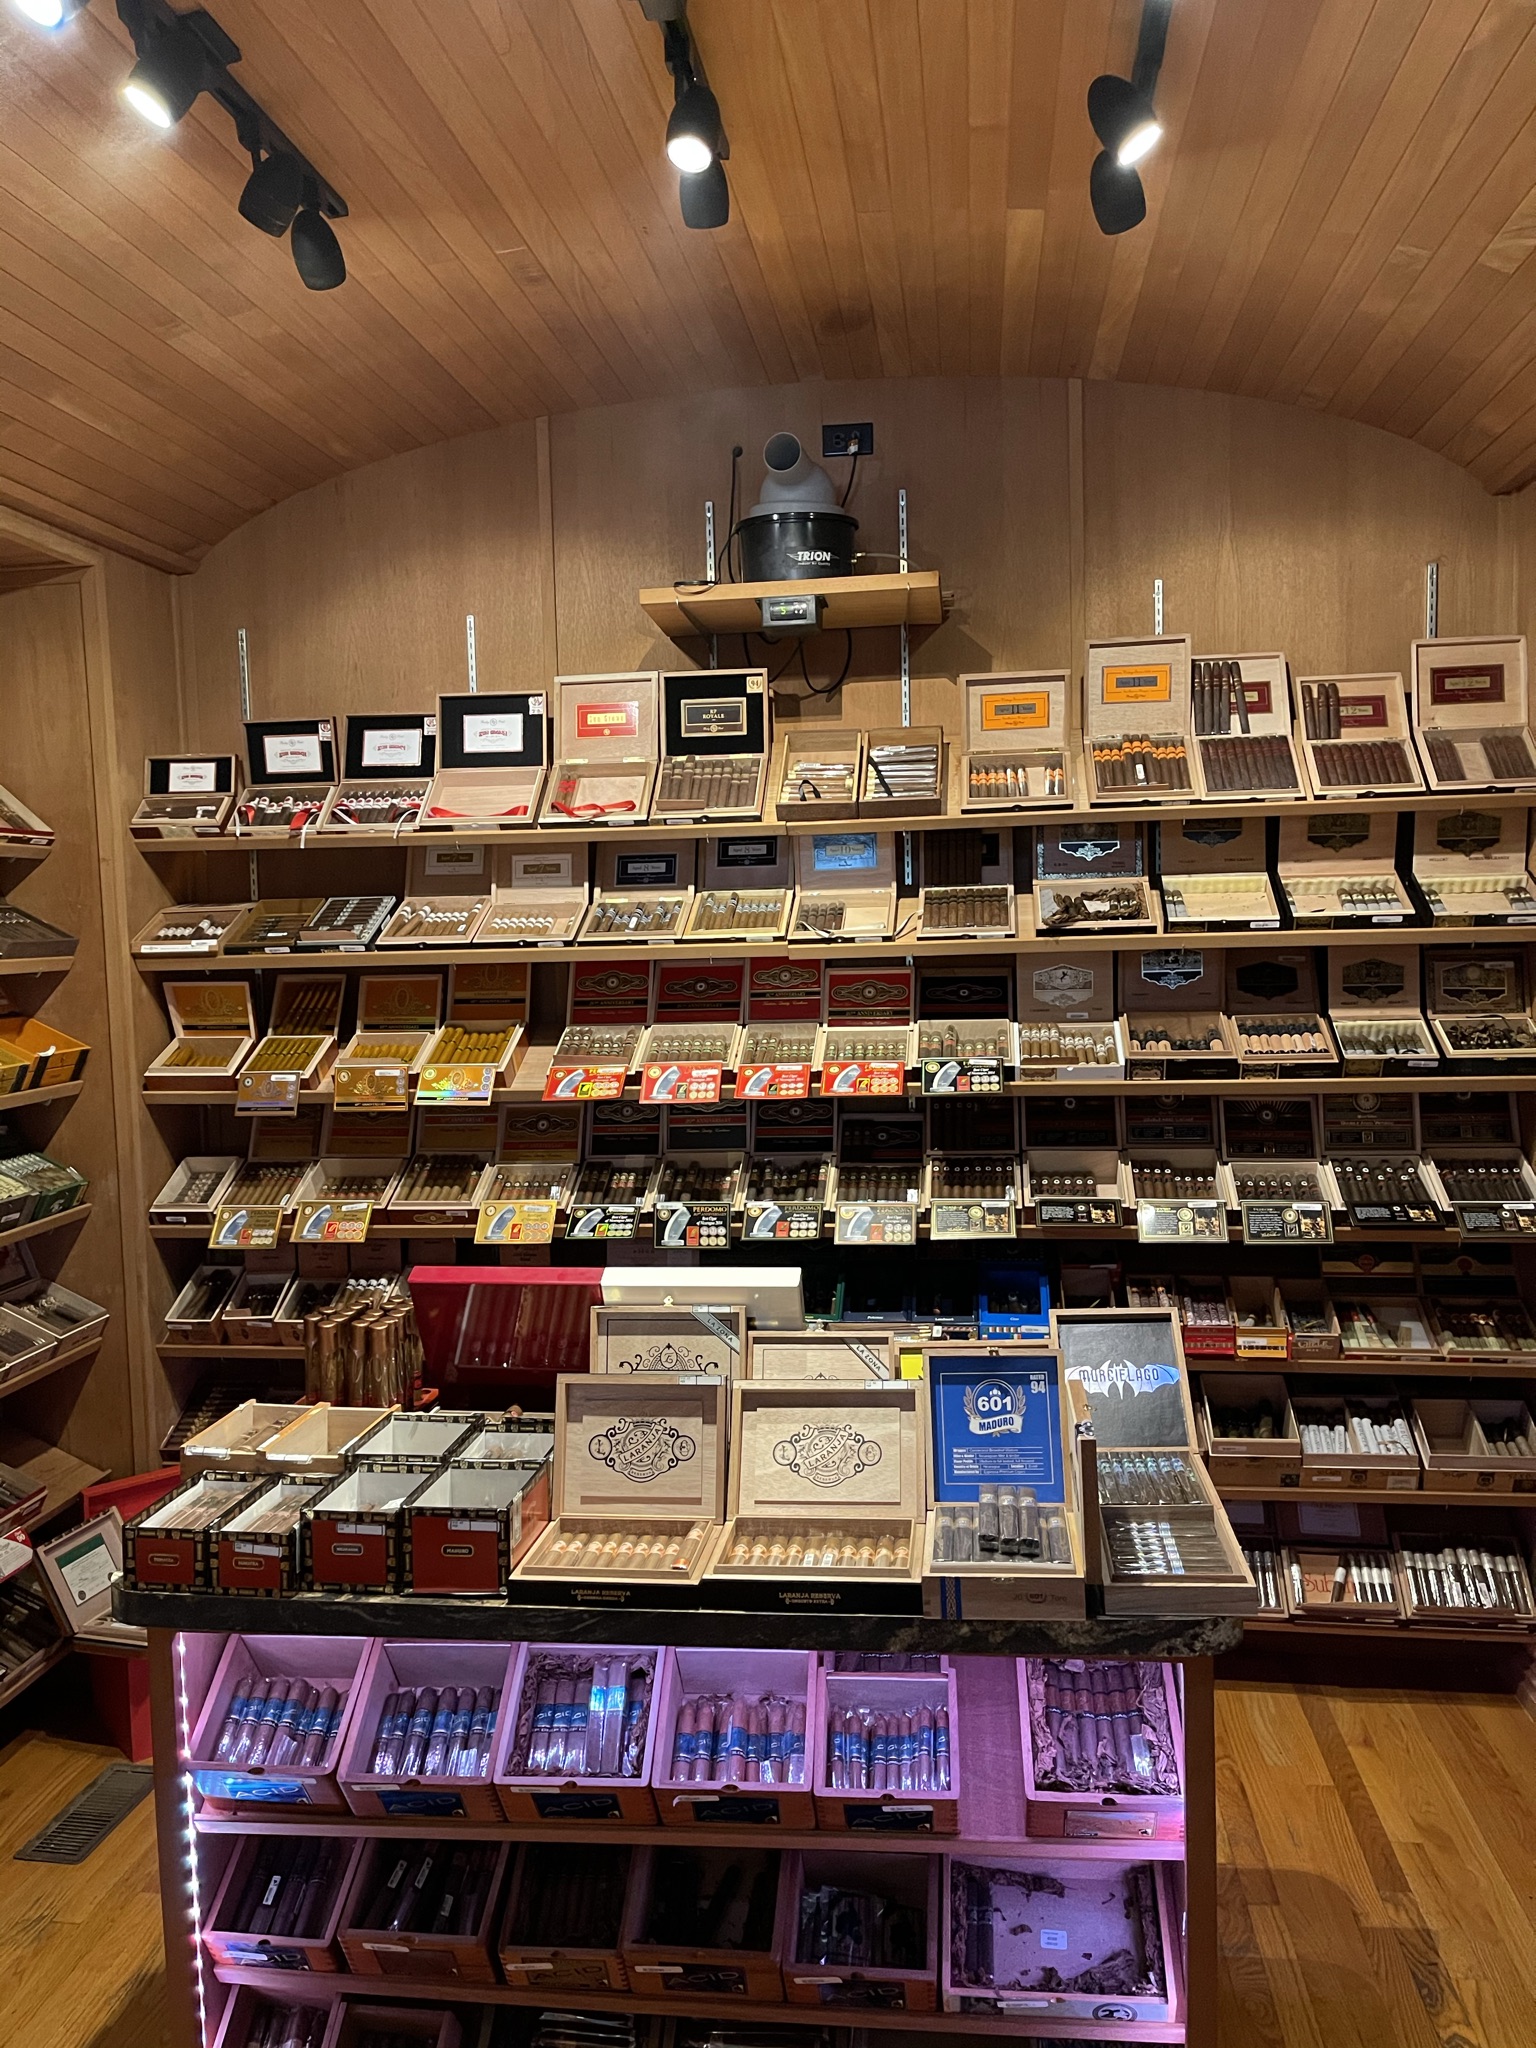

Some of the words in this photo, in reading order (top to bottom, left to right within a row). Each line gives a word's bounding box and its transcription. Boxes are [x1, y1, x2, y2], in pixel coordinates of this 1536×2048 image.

[797, 551, 831, 561] TRION
[707, 1318, 715, 1326] LA
[716, 1325, 733, 1343] ZONA
[856, 1345, 865, 1356] LA
[864, 1354, 881, 1372] ZONA
[1078, 1367, 1160, 1383] MURCIELAGO
[1030, 1381, 1046, 1394] 94
[977, 1395, 1012, 1412] 601
[978, 1416, 1015, 1432] MADURO
[622, 1428, 662, 1462] LARANJA
[808, 1433, 847, 1468] LARANJA
[571, 1589, 600, 1597] LARANJA
[601, 1589, 631, 1597] RESERVA
[235, 1785, 299, 1799] ACID
[389, 1796, 456, 1811] ACID
[544, 1798, 613, 1814] ACID
[700, 1803, 774, 1817] ACID
[851, 1810, 928, 1825] ACID
[533, 1965, 603, 1980] ACID
[668, 1971, 739, 1986] ACID
[826, 1986, 900, 2001] ACID
